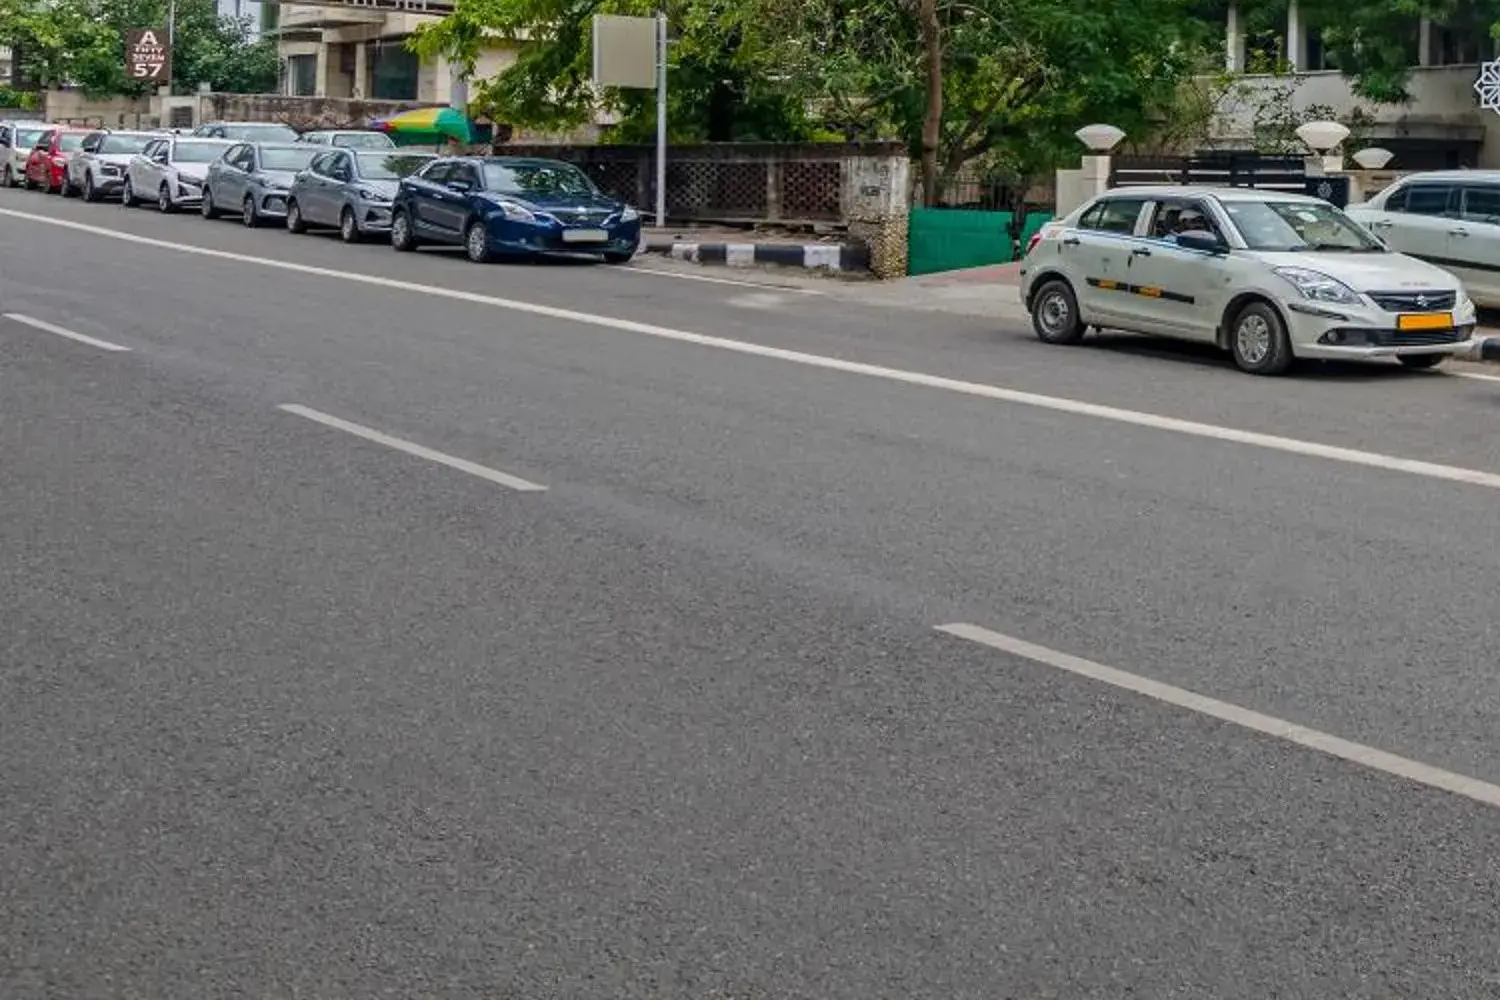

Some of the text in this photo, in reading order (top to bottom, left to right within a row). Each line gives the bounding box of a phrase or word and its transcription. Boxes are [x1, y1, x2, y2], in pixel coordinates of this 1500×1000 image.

[140, 31, 158, 45] A
[132, 53, 165, 62] SEVEN
[133, 63, 162, 77] 57
